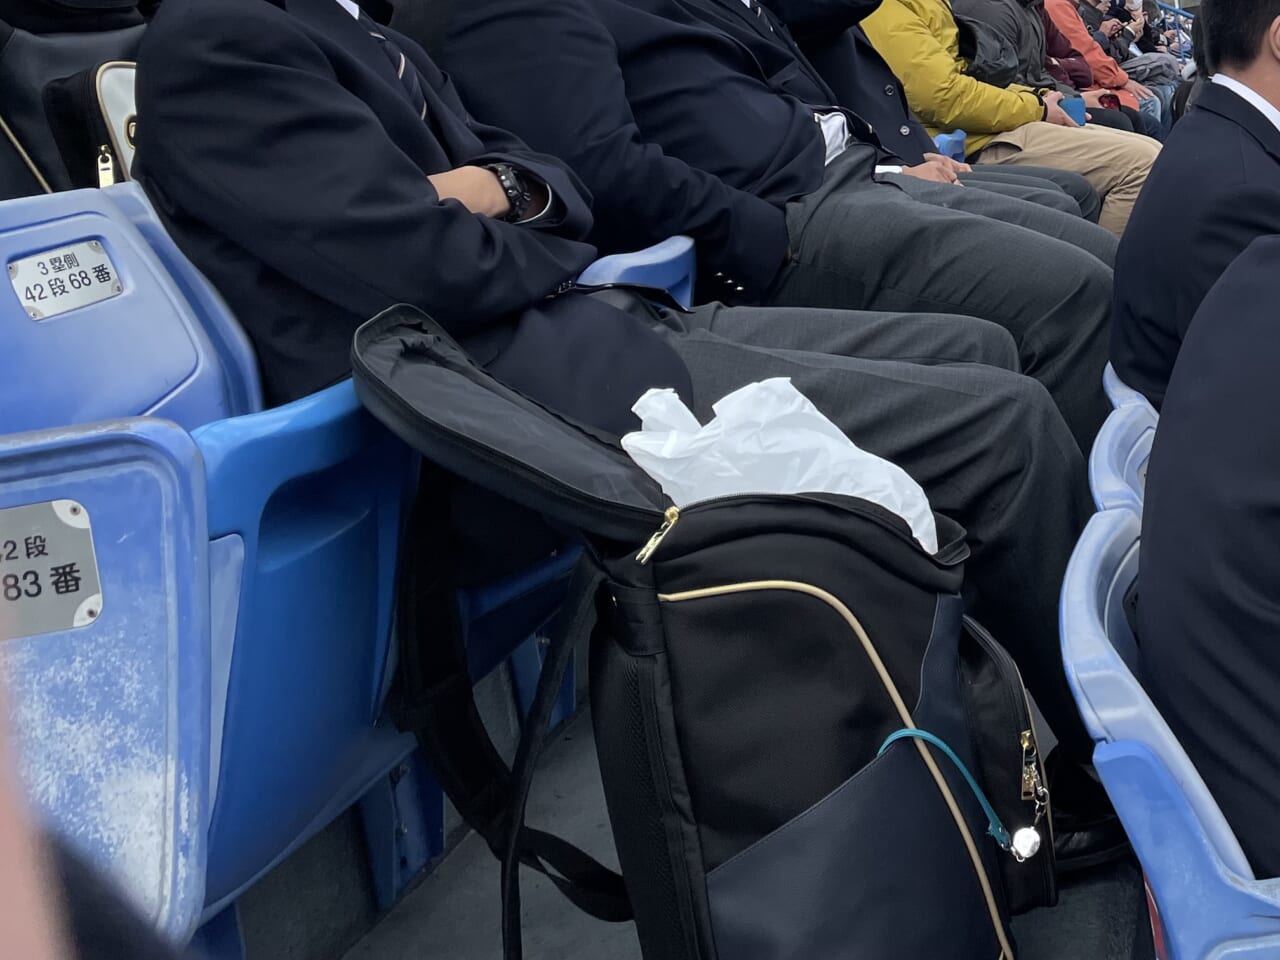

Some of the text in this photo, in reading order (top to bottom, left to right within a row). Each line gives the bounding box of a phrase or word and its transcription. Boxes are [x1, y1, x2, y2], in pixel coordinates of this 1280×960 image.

[25, 263, 112, 302] 42段68番
[0, 535, 48, 563] 2段
[2, 562, 82, 602] 83番
